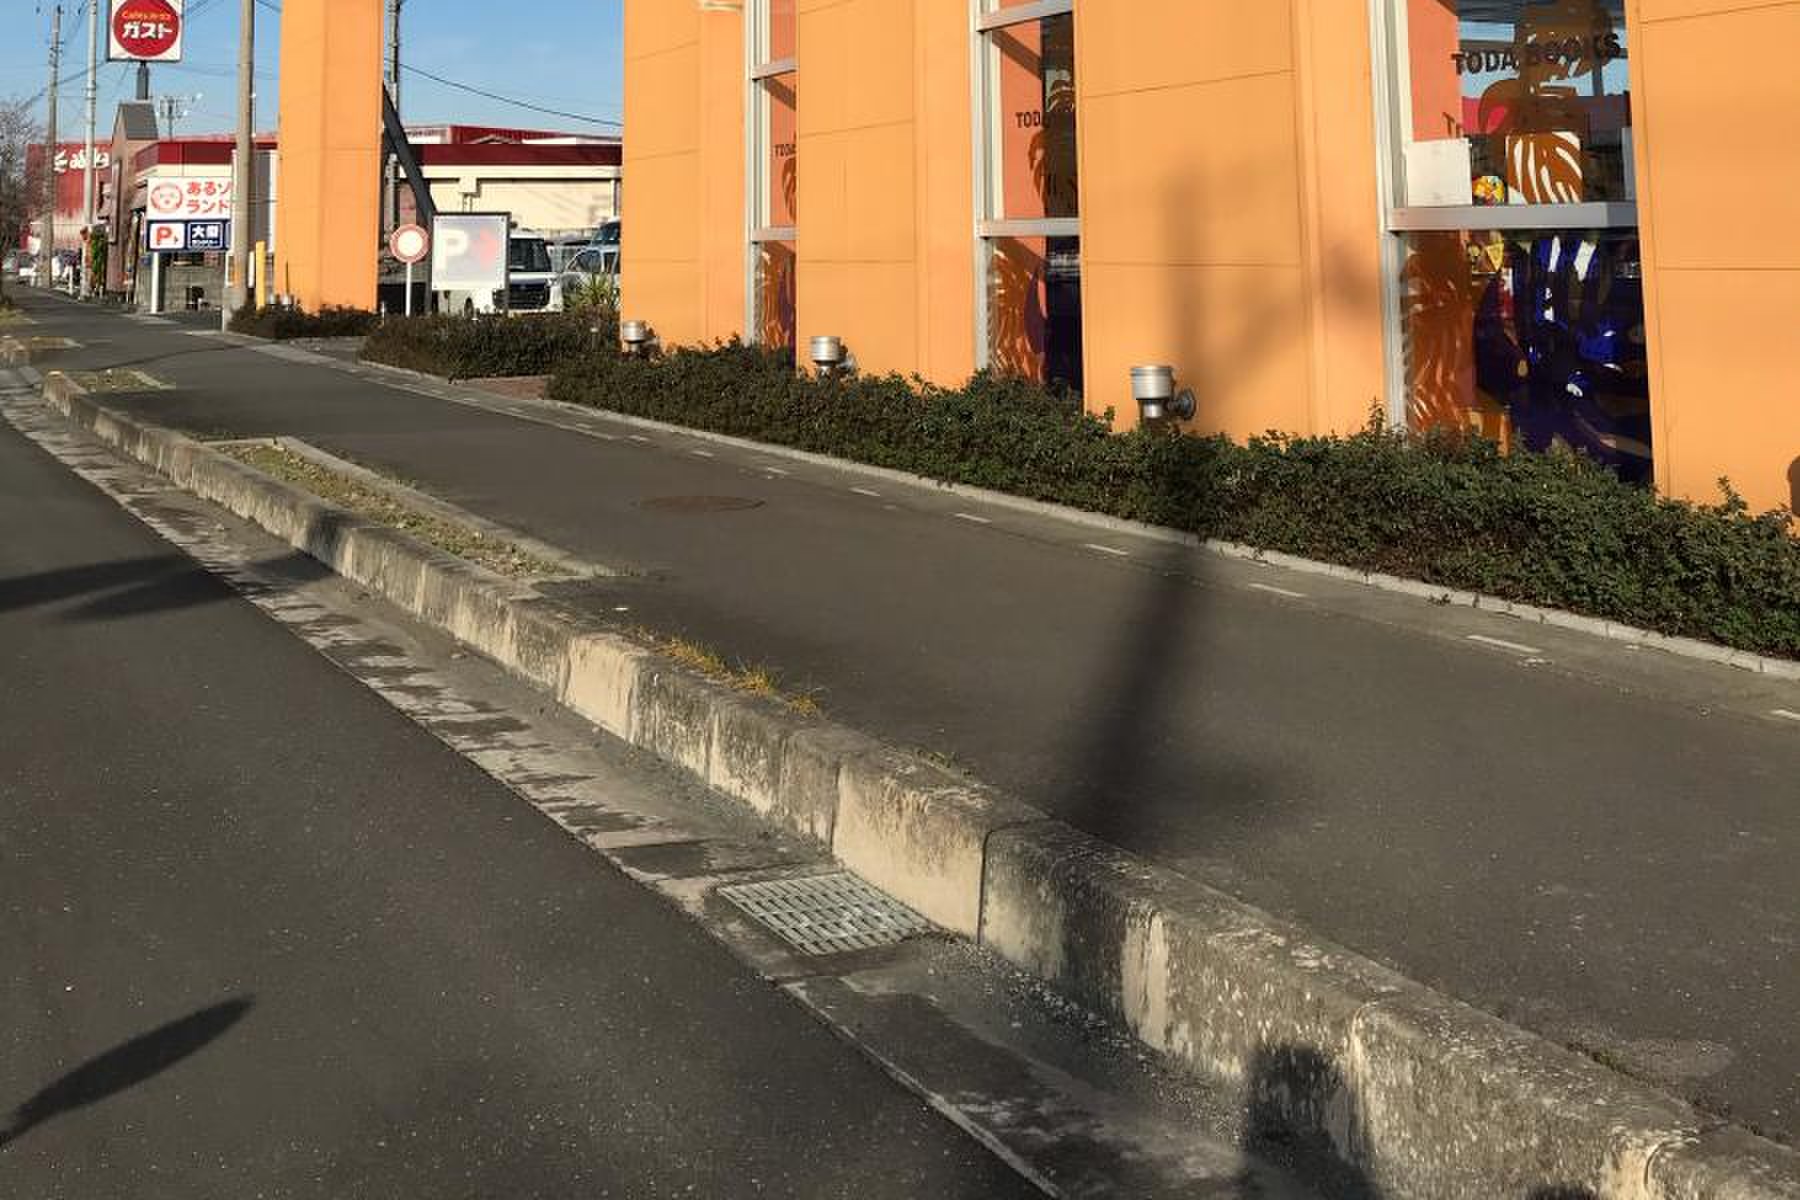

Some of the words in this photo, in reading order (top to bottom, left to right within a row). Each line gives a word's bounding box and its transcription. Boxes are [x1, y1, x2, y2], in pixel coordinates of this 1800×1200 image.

[121, 21, 173, 40] ガスト
[1451, 48, 1520, 75] TODA
[156, 226, 173, 246] P
